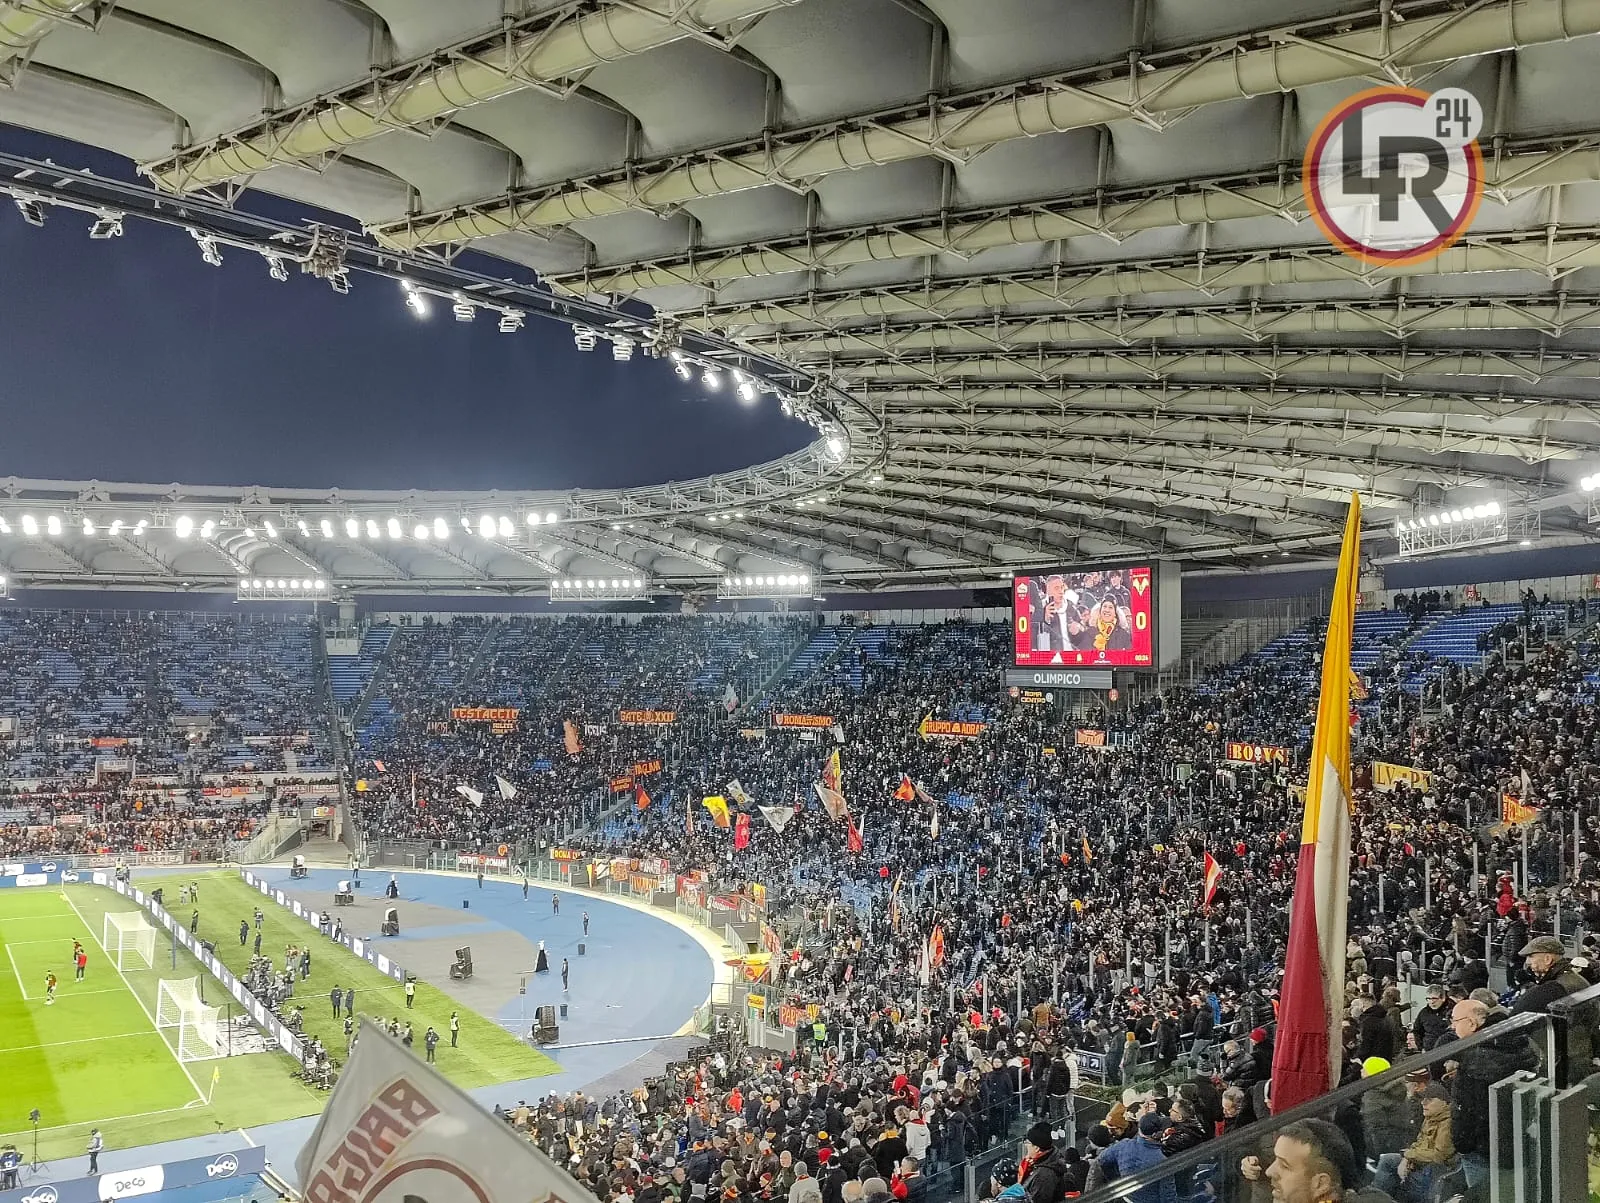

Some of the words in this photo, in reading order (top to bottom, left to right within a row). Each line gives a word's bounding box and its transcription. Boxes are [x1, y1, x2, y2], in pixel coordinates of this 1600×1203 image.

[1018, 616, 1028, 633] 0
[1135, 611, 1147, 630] 0
[1033, 673, 1081, 685] OLIMPICO
[452, 708, 519, 719] TESTACCIO
